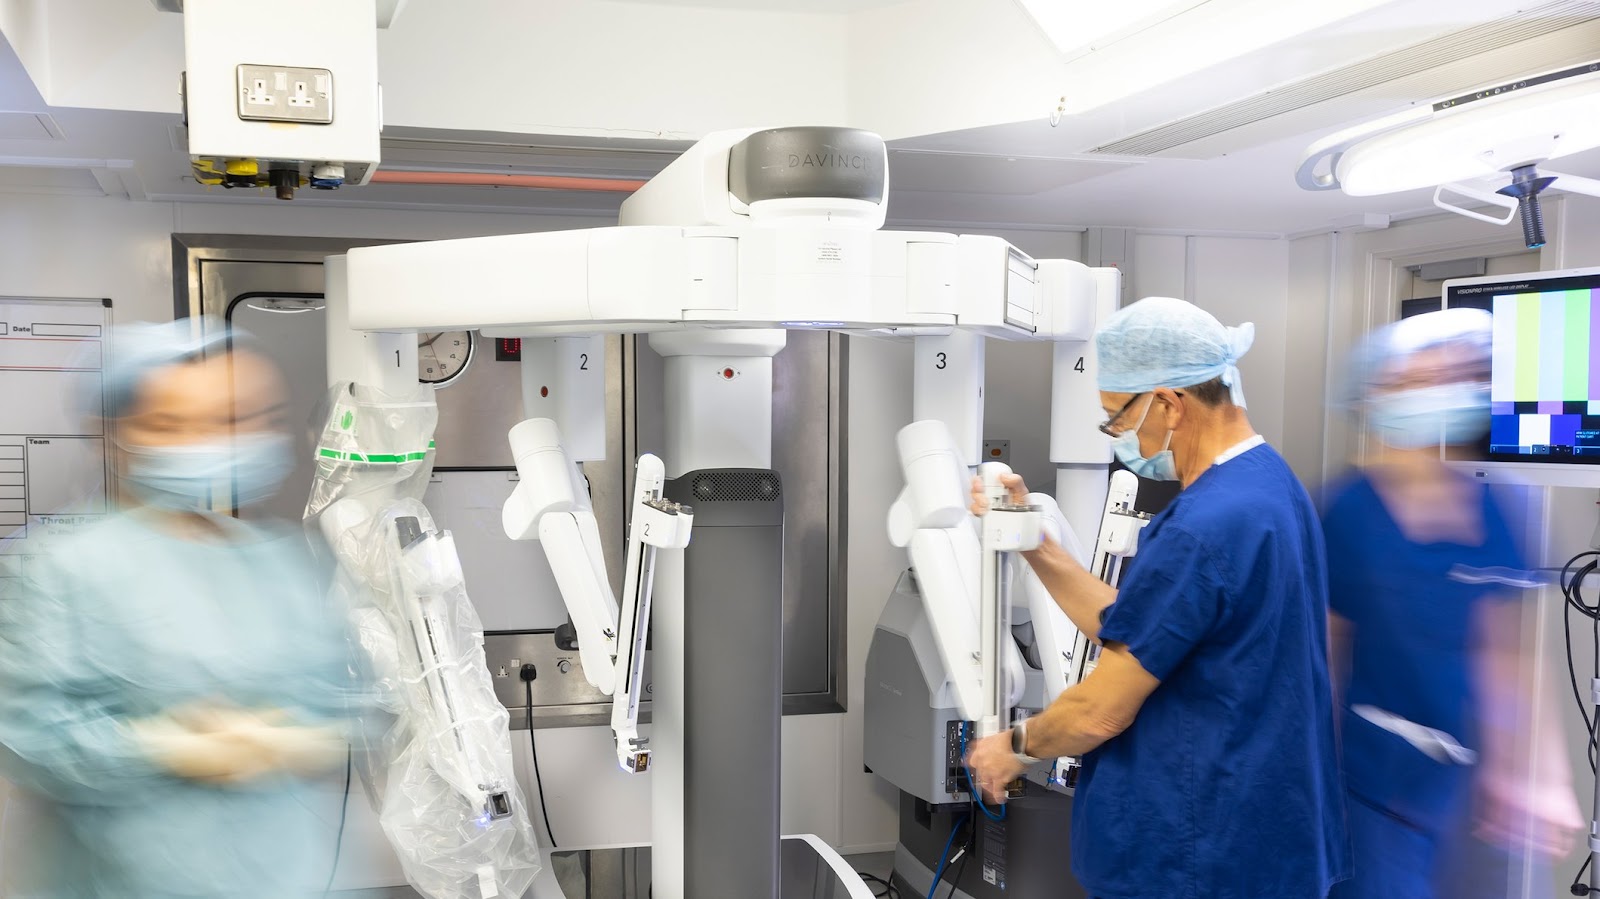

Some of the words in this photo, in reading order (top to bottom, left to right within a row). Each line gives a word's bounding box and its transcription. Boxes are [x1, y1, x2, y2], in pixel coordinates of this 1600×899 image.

[787, 153, 867, 169] DAVINCI
[395, 349, 400, 368] 1
[580, 353, 588, 370] 2
[935, 352, 947, 370] 3
[1073, 356, 1085, 373] 4
[40, 516, 75, 525] Throat
[643, 523, 650, 537] 2
